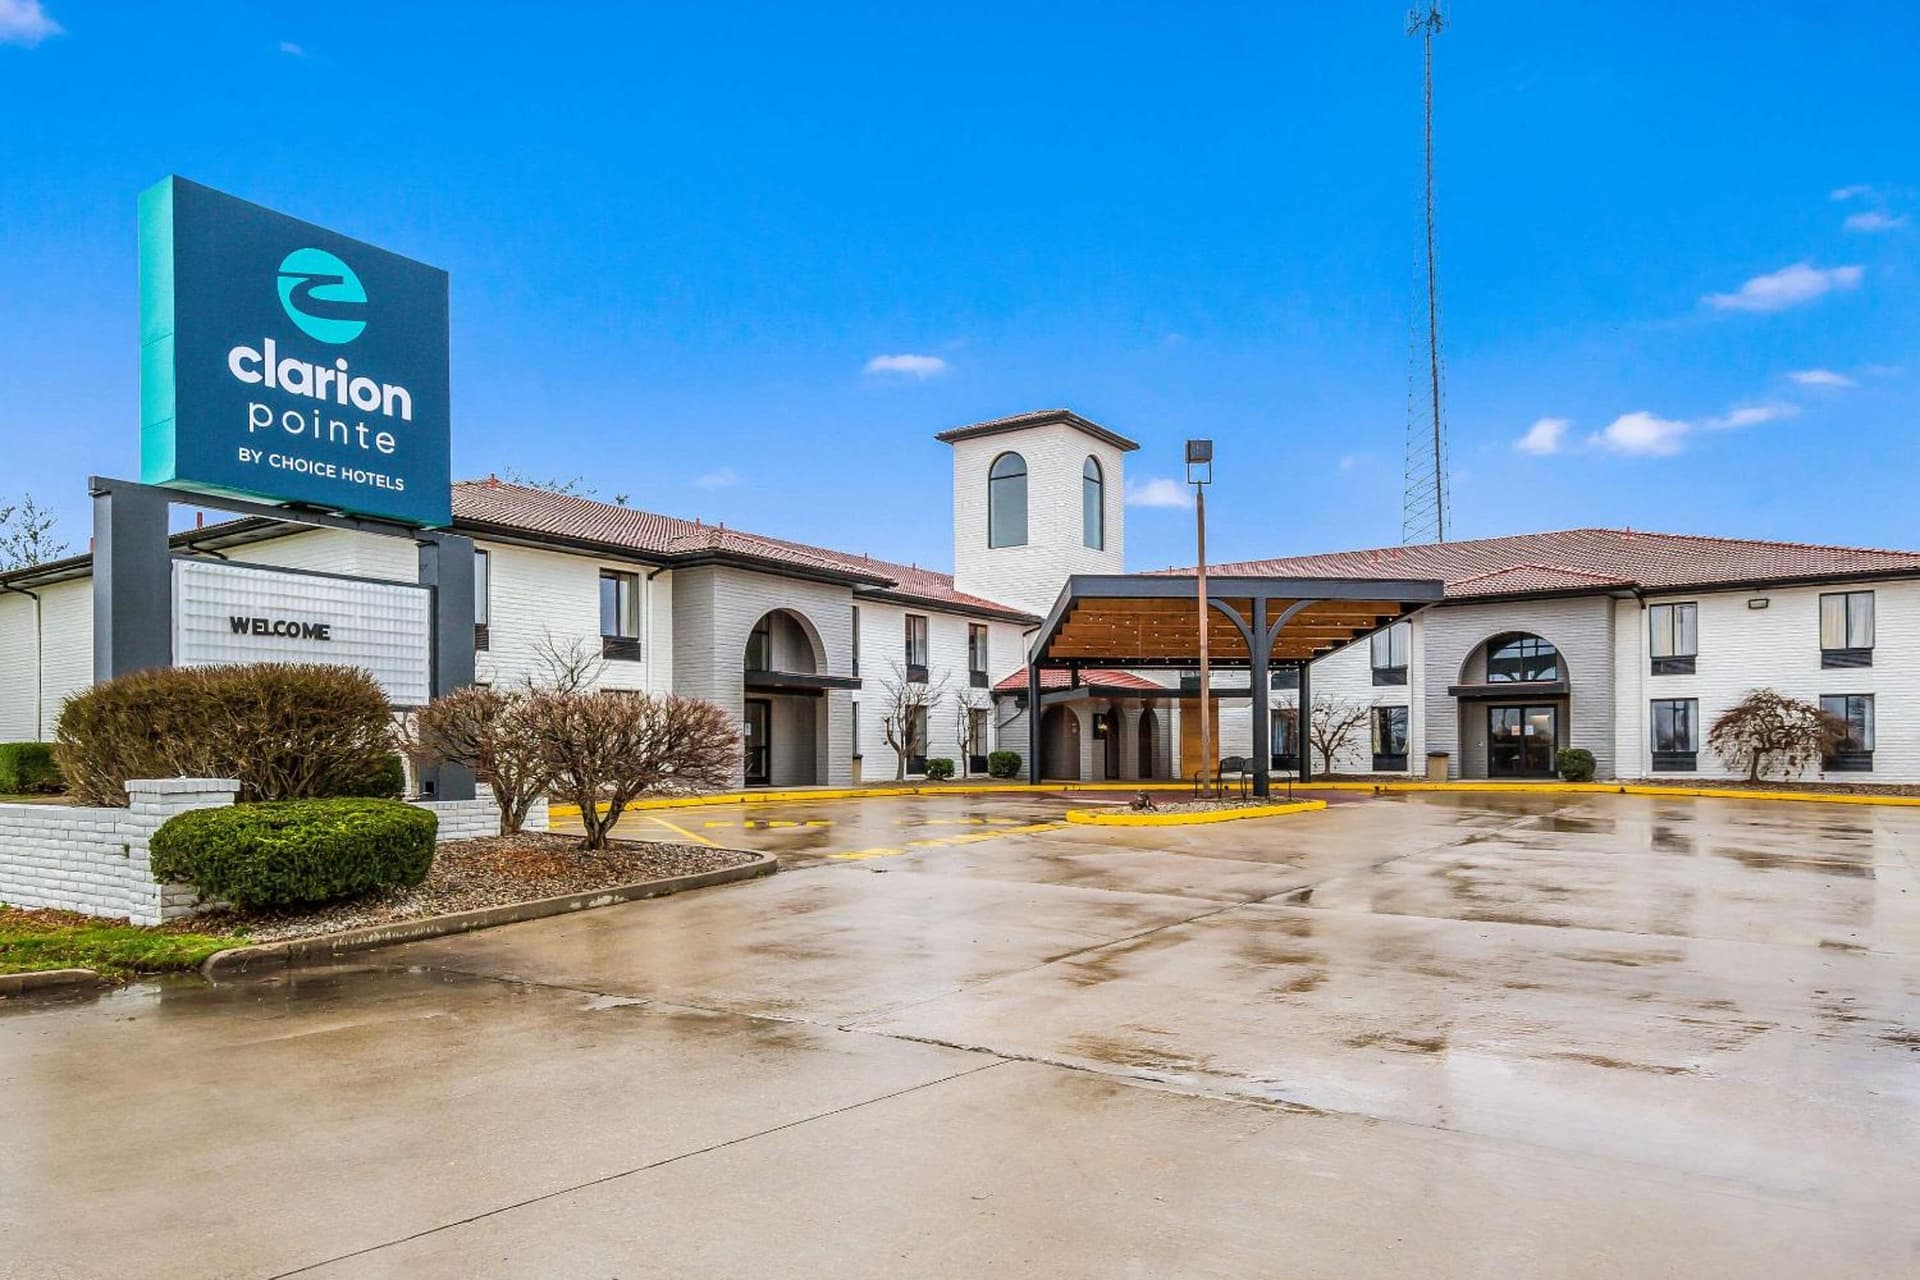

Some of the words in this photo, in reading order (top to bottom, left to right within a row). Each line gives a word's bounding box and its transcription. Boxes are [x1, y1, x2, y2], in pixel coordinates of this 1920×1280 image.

[227, 337, 412, 421] clarion
[248, 402, 396, 454] pointe
[238, 447, 264, 464] BY
[268, 453, 337, 478] CHOICE
[341, 467, 405, 491] HOTELS
[229, 615, 331, 641] WELCOME
